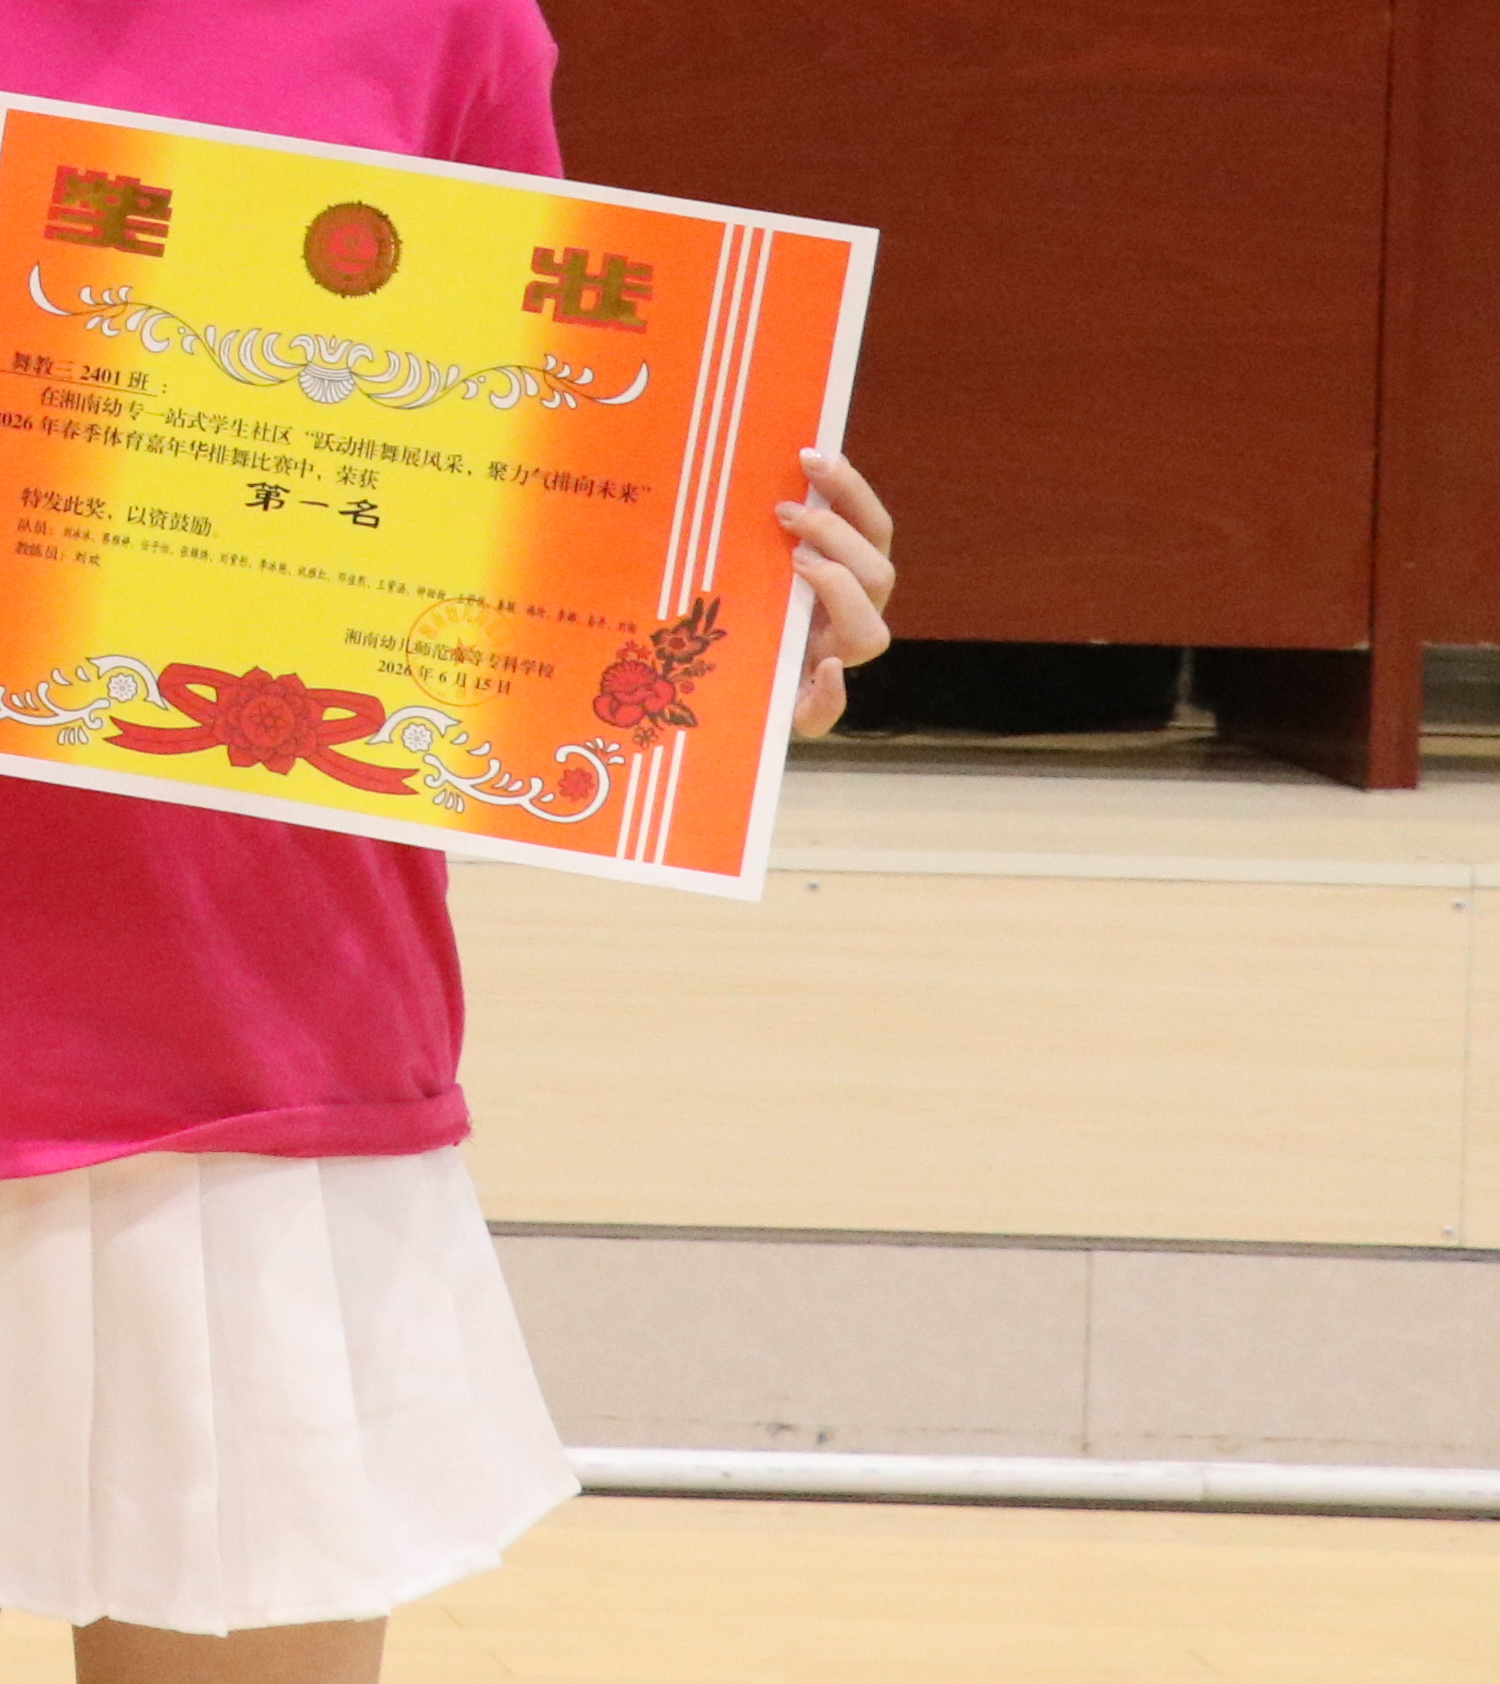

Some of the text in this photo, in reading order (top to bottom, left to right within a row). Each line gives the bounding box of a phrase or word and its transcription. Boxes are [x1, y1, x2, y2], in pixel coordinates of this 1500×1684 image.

[245, 482, 381, 529] 第一名
[345, 628, 556, 679] 湘南幼儿师范高等专科学校
